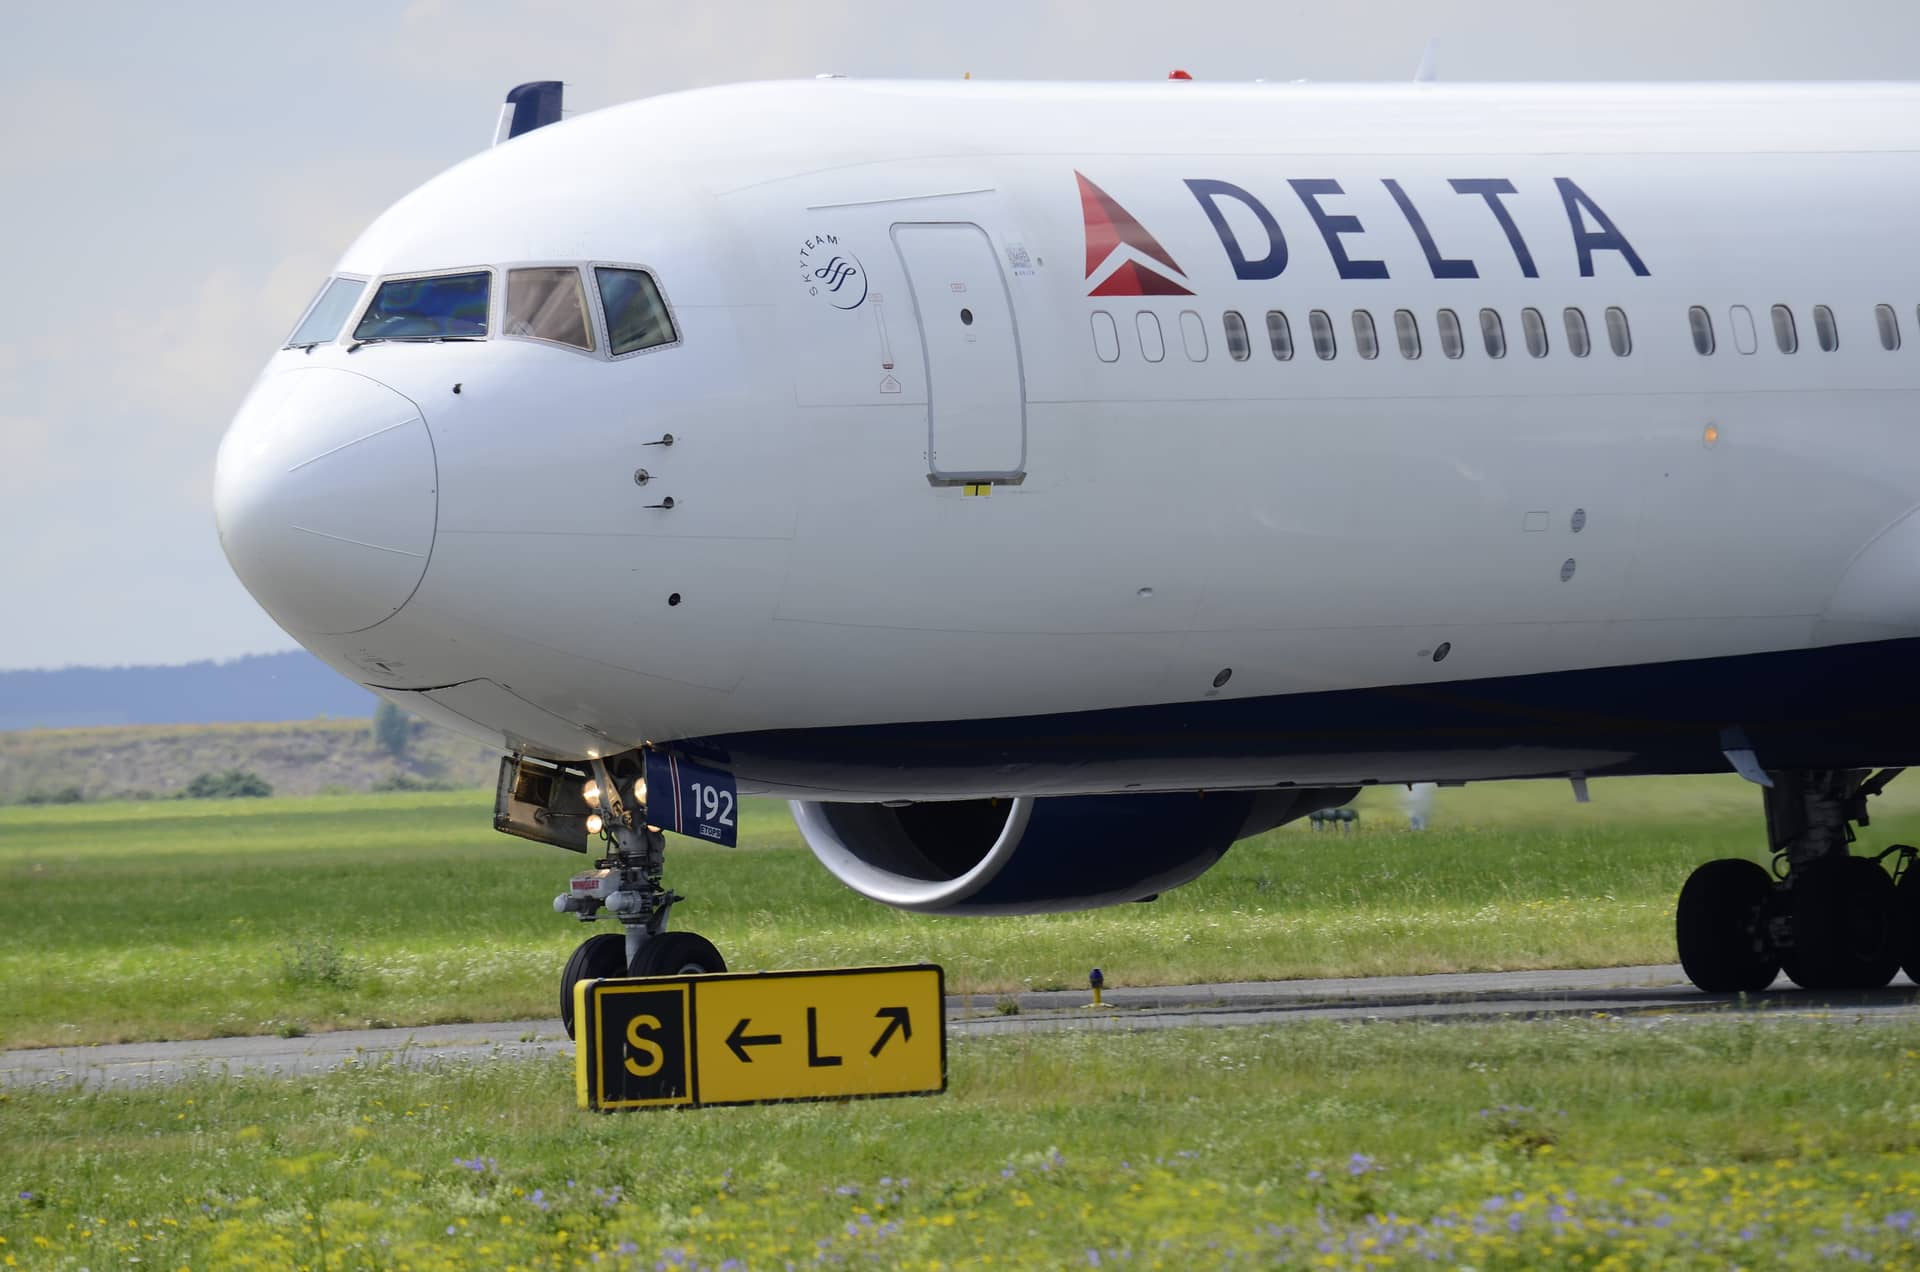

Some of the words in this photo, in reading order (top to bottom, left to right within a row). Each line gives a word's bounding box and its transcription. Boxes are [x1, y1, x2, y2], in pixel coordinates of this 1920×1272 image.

[1182, 177, 1652, 281] DELTA
[799, 234, 839, 297] SKYTEAM
[691, 783, 734, 827] 192
[623, 1014, 665, 1078] S
[806, 1006, 843, 1068] L
